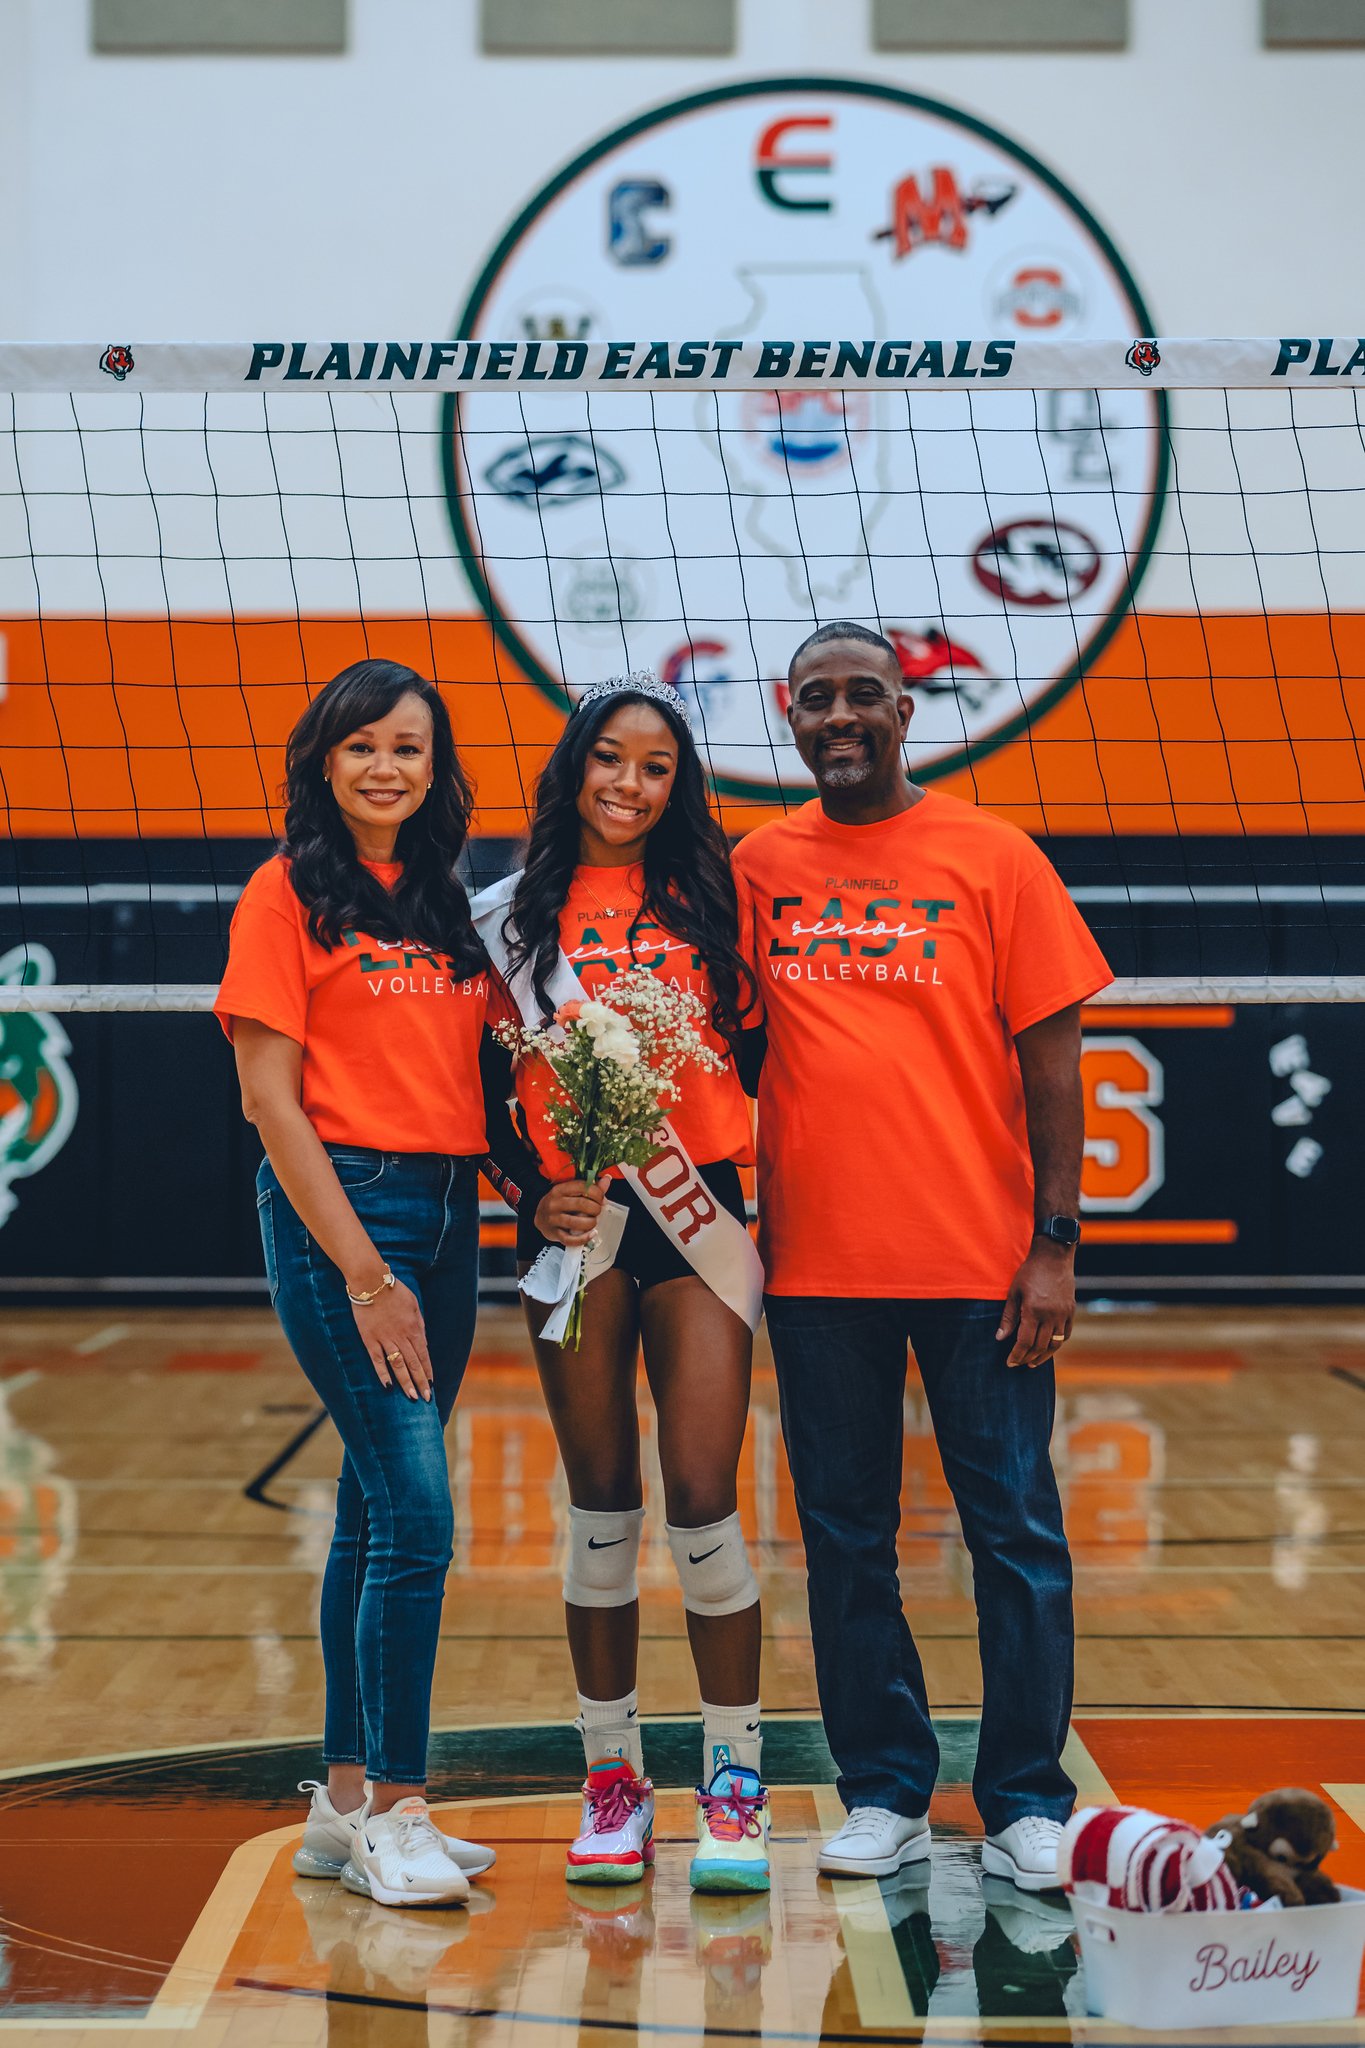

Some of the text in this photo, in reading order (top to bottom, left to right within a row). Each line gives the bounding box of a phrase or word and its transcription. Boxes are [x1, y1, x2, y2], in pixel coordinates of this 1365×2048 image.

[244, 340, 1016, 380] PLAINFIELD EAST BENGALS
[825, 877, 899, 891] PLAINFIELD
[768, 896, 956, 960] EAST
[791, 920, 927, 938] senior
[770, 962, 943, 985] VOLLEYBALL
[1189, 1938, 1320, 1992] Bailey
